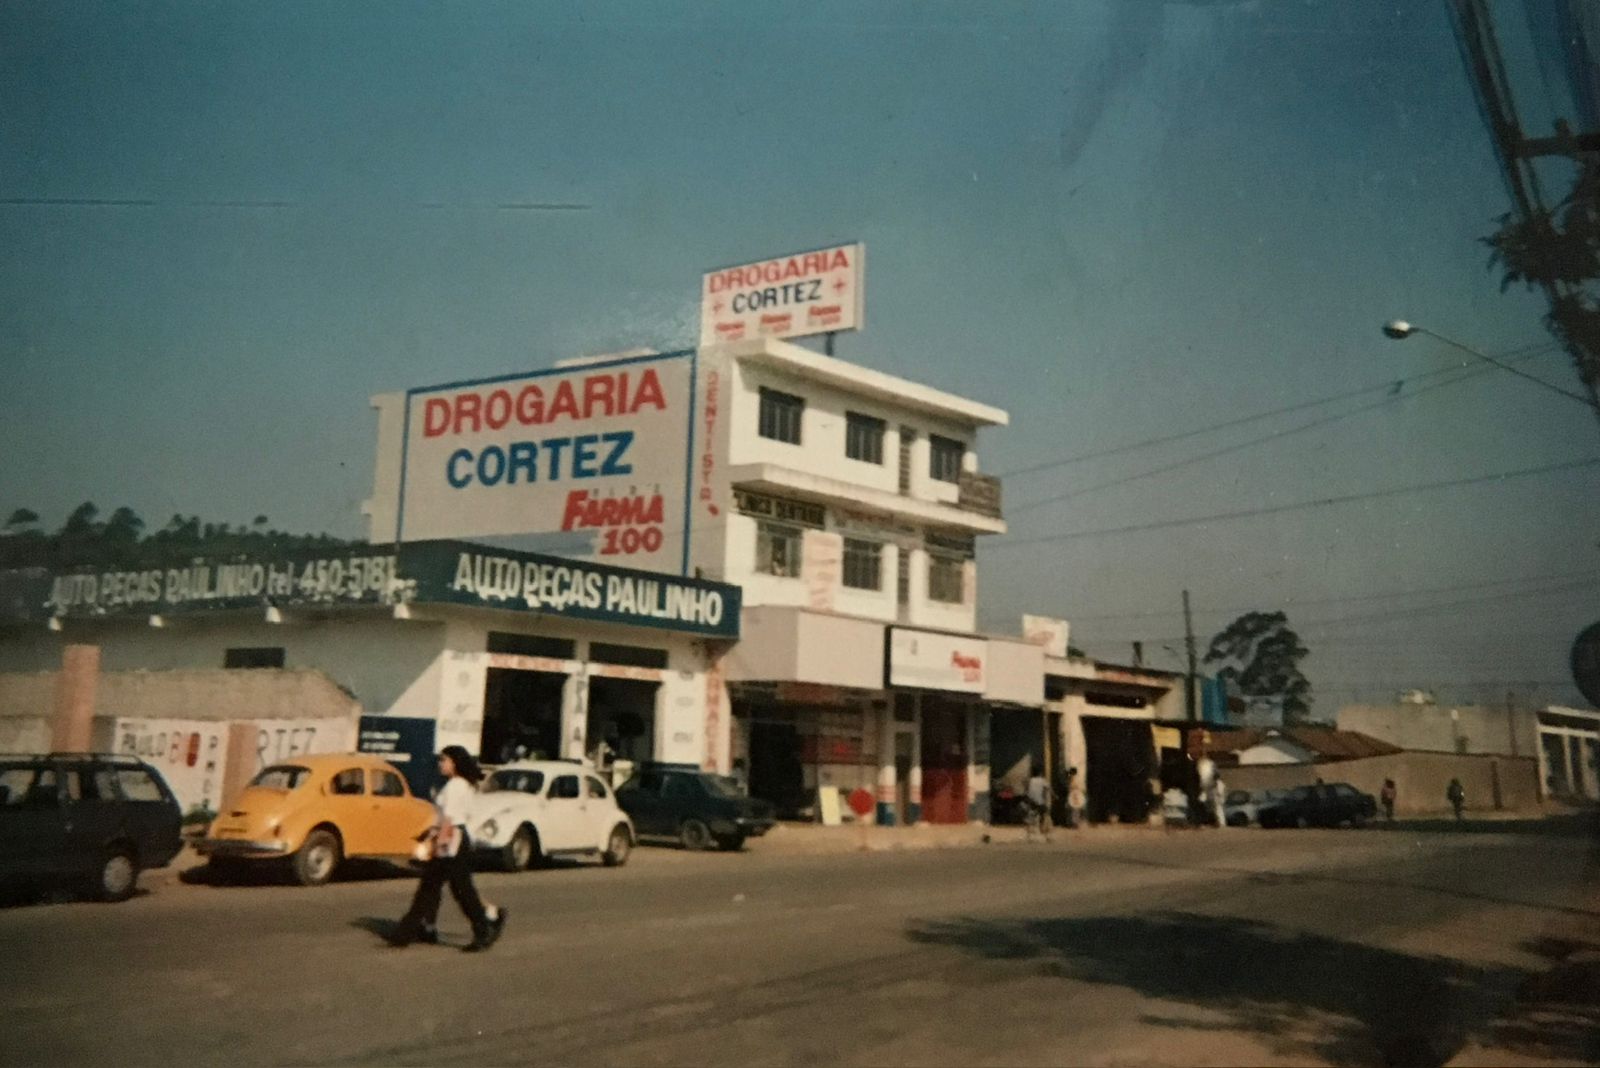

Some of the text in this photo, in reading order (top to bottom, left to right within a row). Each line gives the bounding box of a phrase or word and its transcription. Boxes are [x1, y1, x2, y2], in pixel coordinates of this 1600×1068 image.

[709, 249, 849, 293] DROGARIA
[732, 279, 822, 314] CORTEZ
[424, 368, 666, 438] DROGARIA
[447, 431, 635, 489] CORTEZ
[599, 527, 663, 556] 100
[49, 573, 99, 604] AUTO
[165, 562, 265, 601] PAULINHO
[453, 552, 724, 627] AUTO PEÇAS PAULINHO
